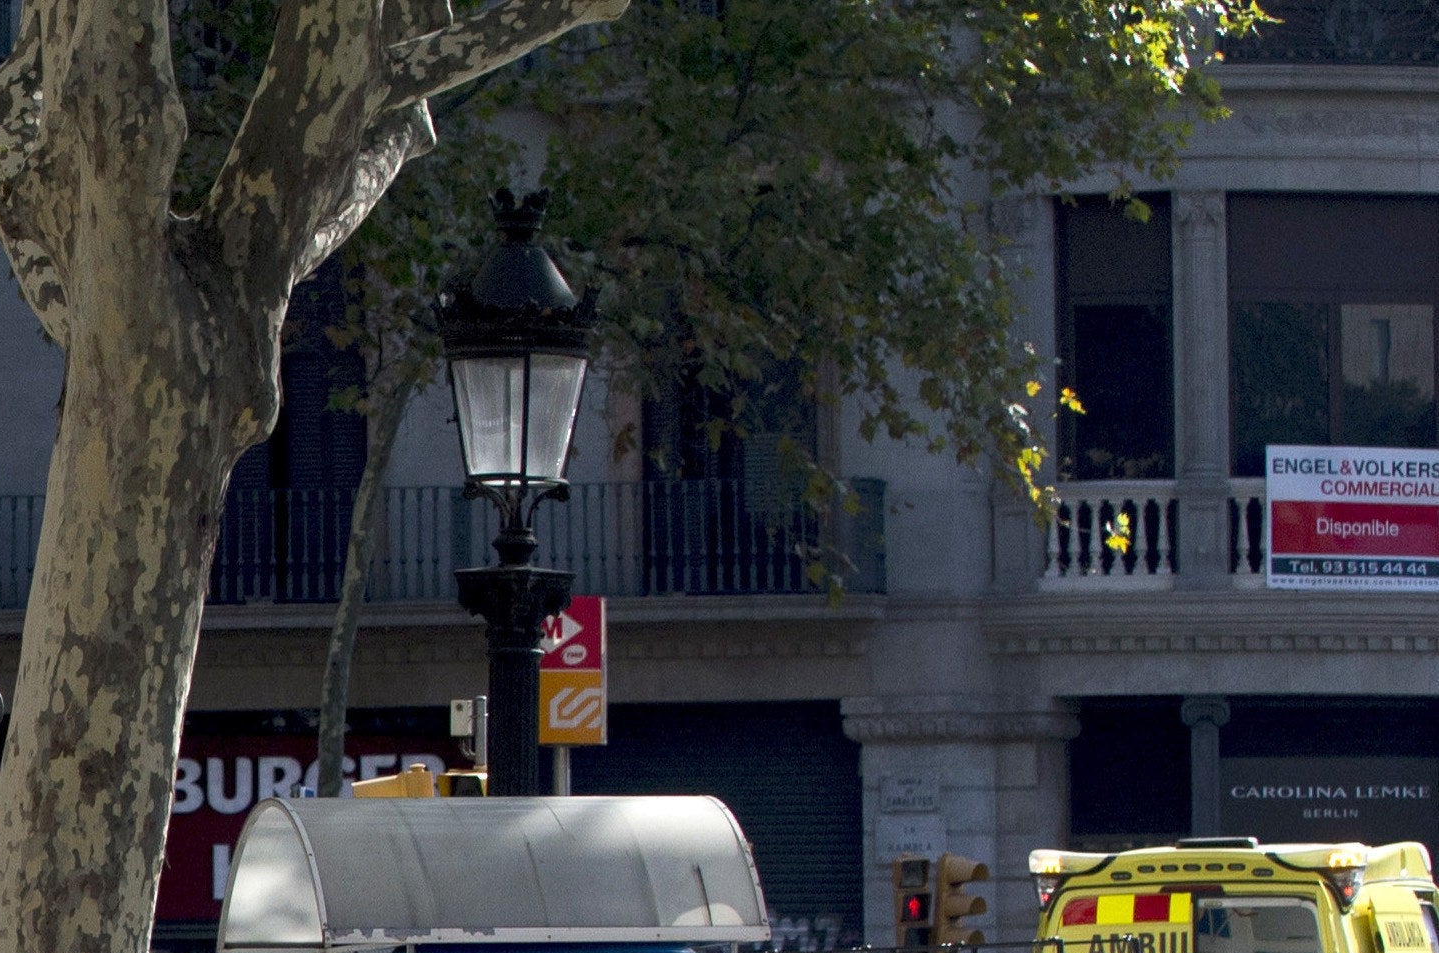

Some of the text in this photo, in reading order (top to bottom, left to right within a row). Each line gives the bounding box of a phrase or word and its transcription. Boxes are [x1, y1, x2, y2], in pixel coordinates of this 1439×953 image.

[1321, 479, 1439, 498] COMMERCIAL
[1316, 517, 1399, 539] Disponible
[1289, 560, 1428, 576] Tel. 93 515 44 44
[1231, 786, 1430, 799] CAROLINA LEMKE
[1302, 808, 1359, 819] BERLIN
